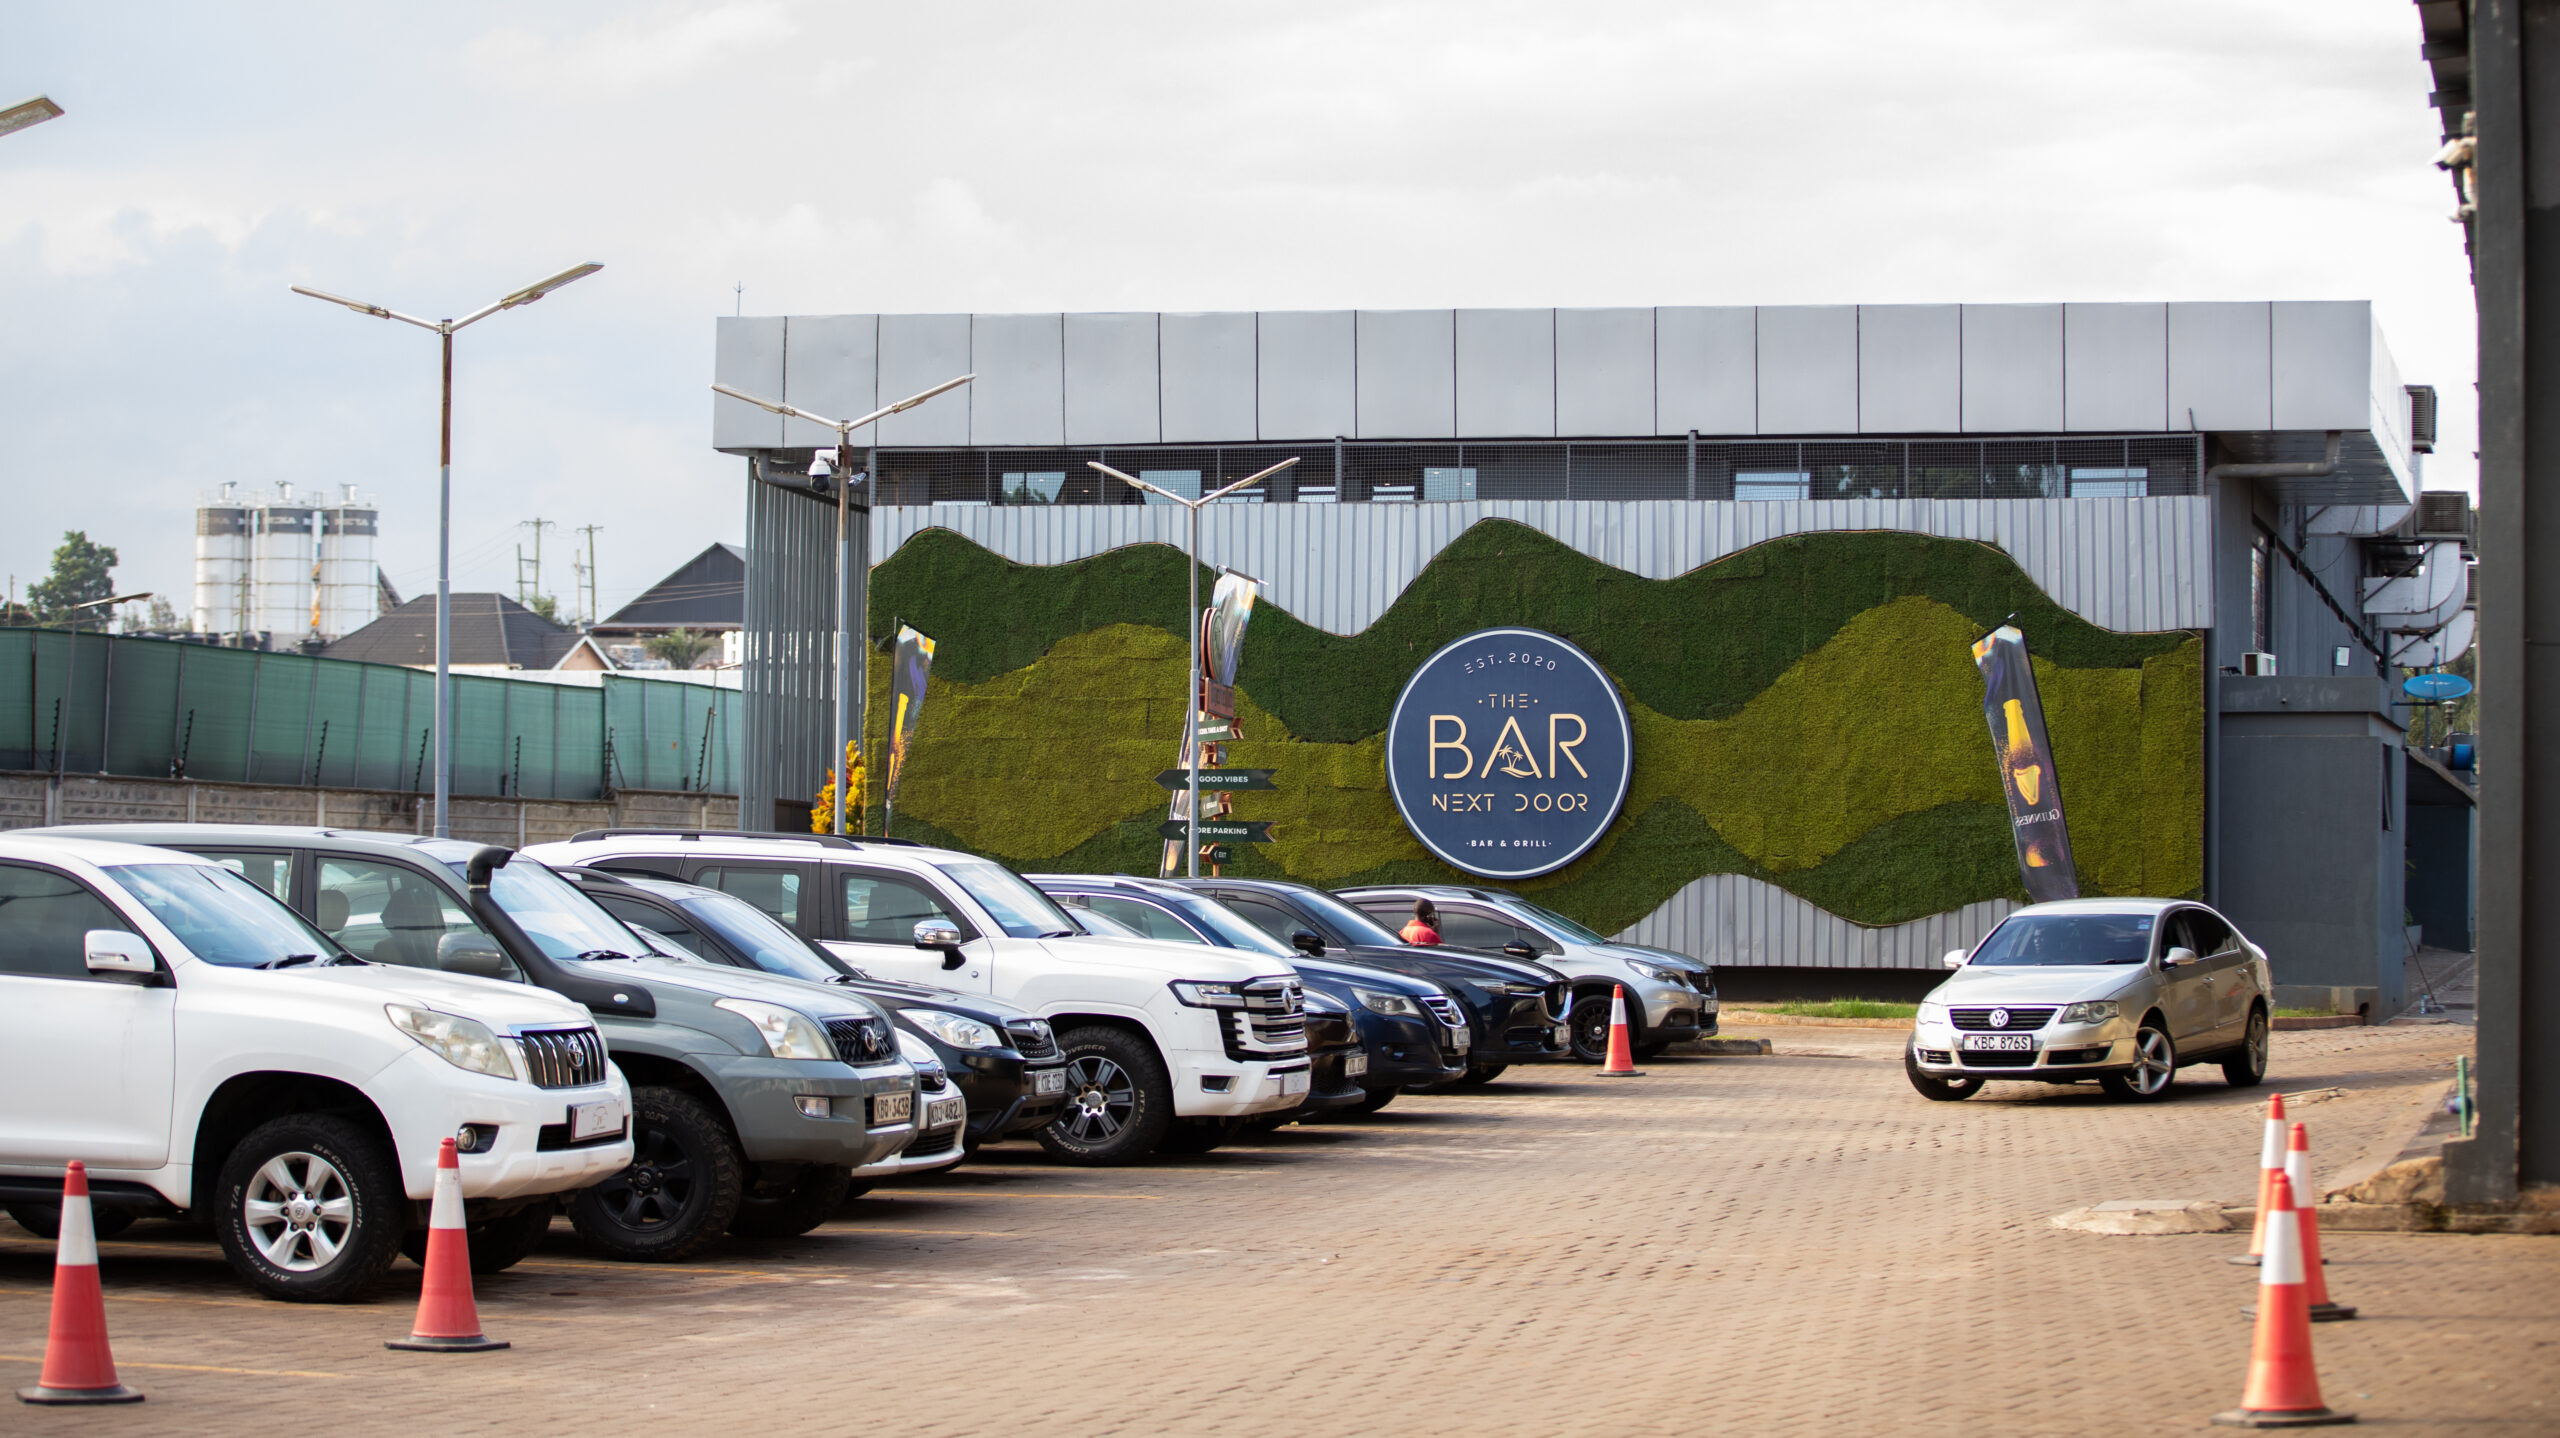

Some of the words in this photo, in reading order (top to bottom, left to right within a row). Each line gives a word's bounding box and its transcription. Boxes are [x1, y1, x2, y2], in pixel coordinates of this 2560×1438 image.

[1429, 713, 1588, 780] BAR
[1432, 793, 1495, 812] NEXT
[1515, 793, 1589, 812] DOOR
[1213, 827, 1248, 835] PARKING
[1471, 839, 1493, 847] BAR
[1513, 839, 1547, 847] GRILL
[1974, 1036, 1995, 1050] KBC
[2000, 1036, 2028, 1050] 876S
[1066, 1044, 1107, 1056] OVERER
